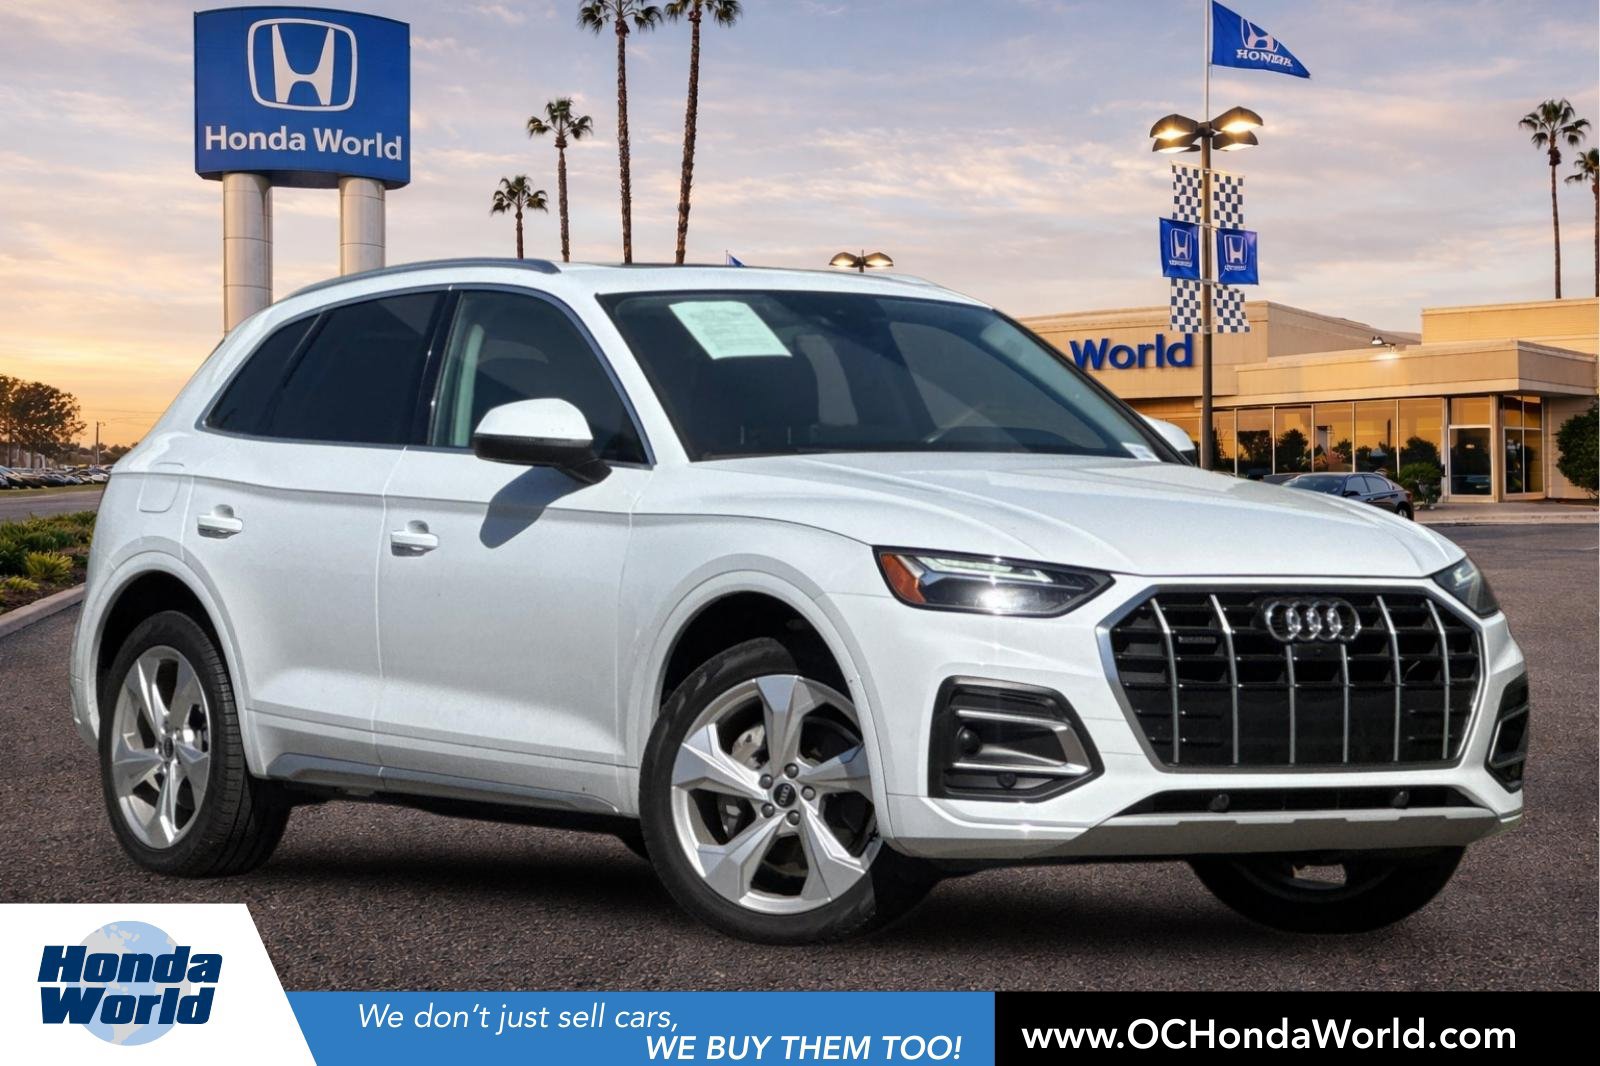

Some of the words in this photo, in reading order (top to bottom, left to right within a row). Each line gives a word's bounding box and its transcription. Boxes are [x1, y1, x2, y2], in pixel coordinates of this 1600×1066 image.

[205, 125, 306, 151] Honda
[312, 127, 403, 161] World
[1069, 333, 1194, 370] World
